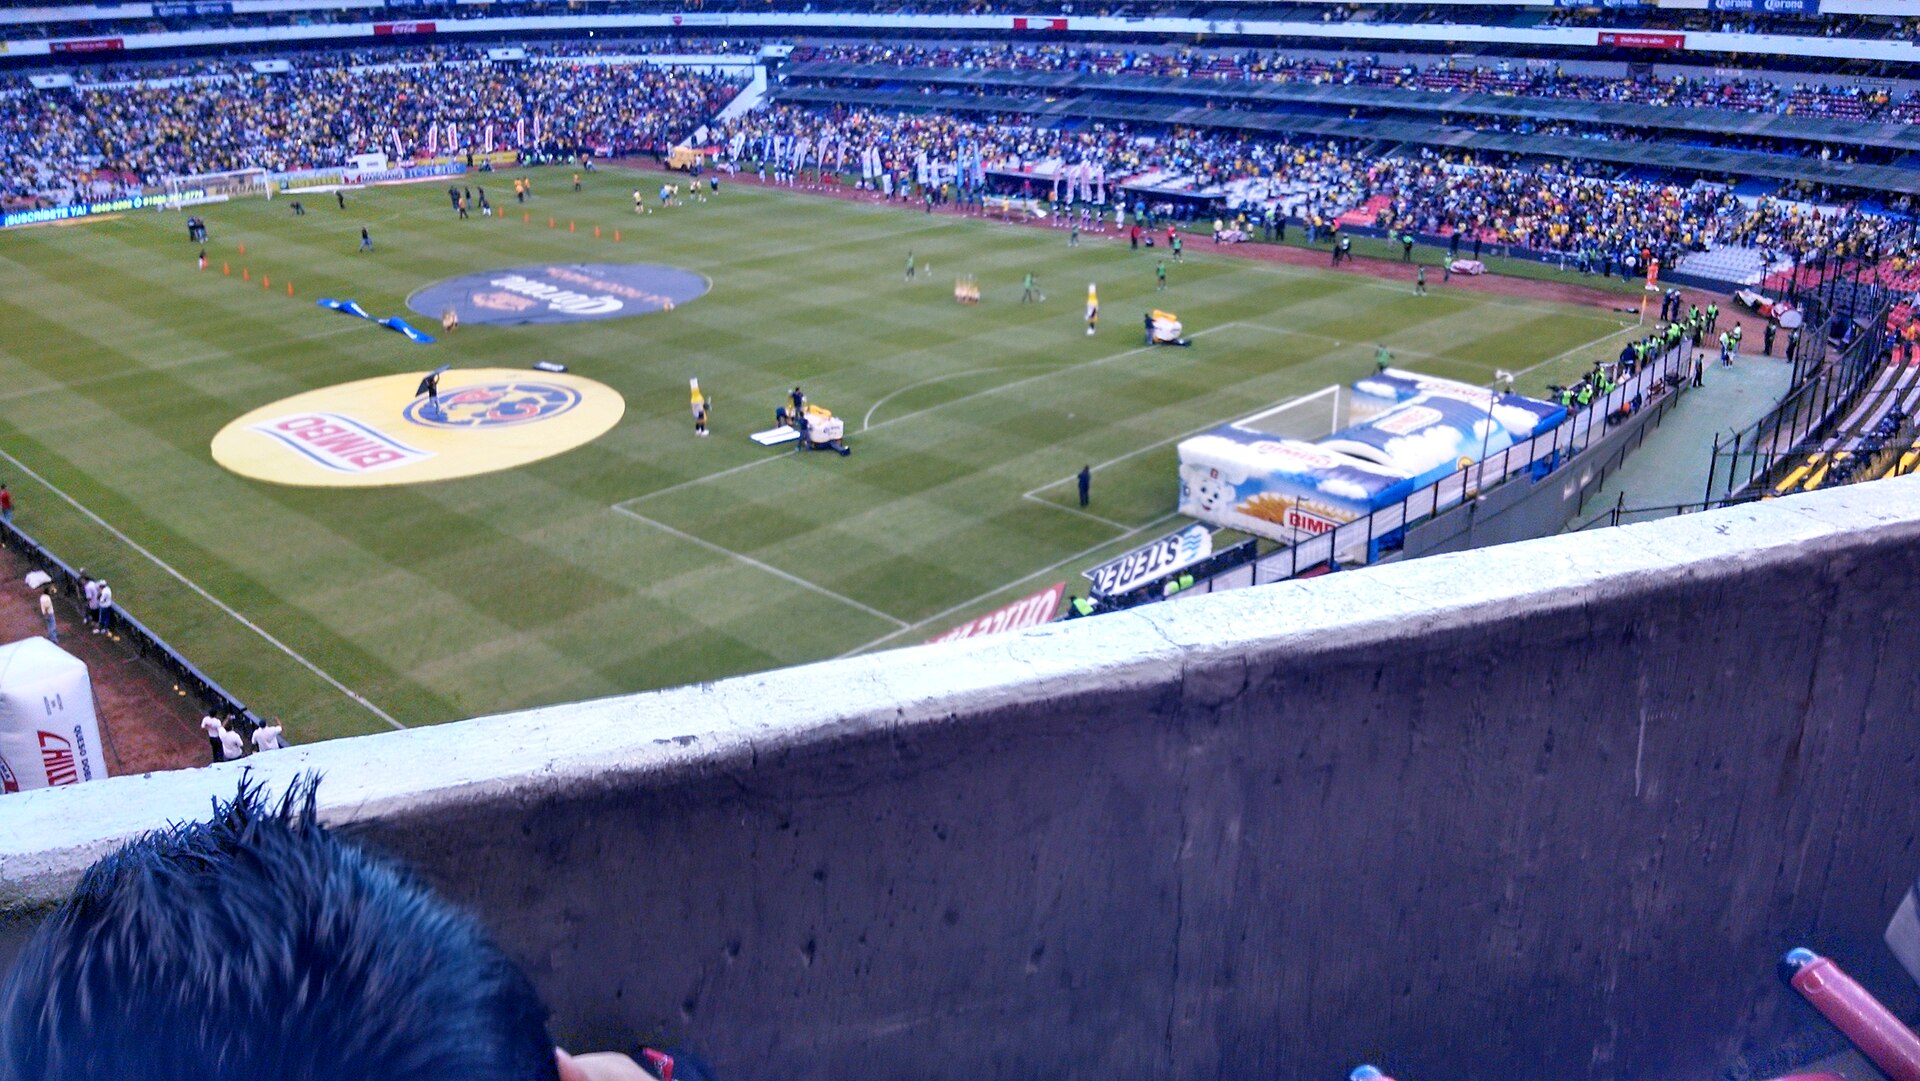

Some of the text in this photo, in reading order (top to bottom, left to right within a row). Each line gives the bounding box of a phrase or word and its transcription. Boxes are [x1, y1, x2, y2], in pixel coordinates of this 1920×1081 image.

[1765, 0, 1802, 11] Corona
[277, 417, 406, 468] BIMBO
[1093, 537, 1180, 592] STEREN
[74, 724, 87, 756] QUESO
